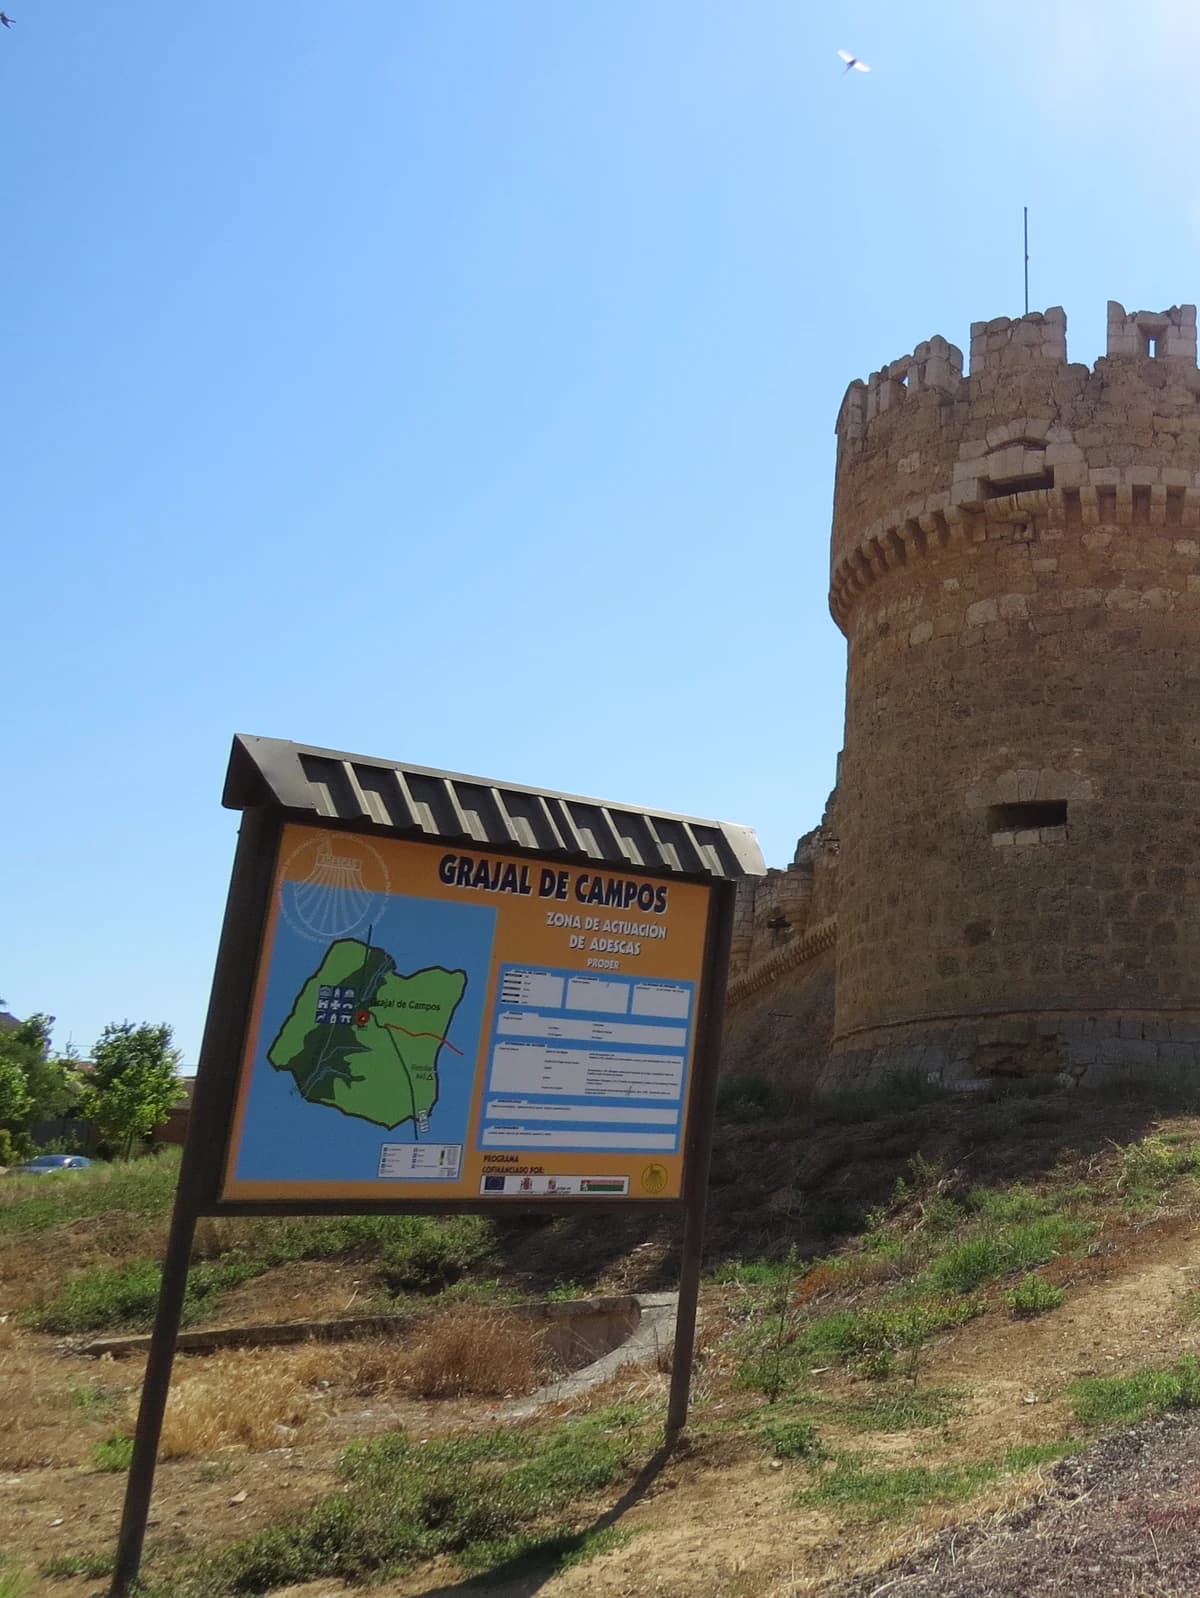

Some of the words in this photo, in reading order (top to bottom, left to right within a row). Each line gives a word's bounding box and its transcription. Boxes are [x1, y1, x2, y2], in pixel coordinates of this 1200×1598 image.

[439, 854, 533, 896] GRAJAL
[538, 869, 570, 901] DE
[575, 874, 669, 914] CAMPOS
[546, 912, 581, 929] ZONA
[584, 918, 600, 931] DE
[602, 920, 667, 939] ACTUACIÓN
[569, 934, 585, 950] DE
[589, 937, 641, 956] ADESCAS
[586, 957, 620, 970] PRODER
[408, 1000, 441, 1011] Campos
